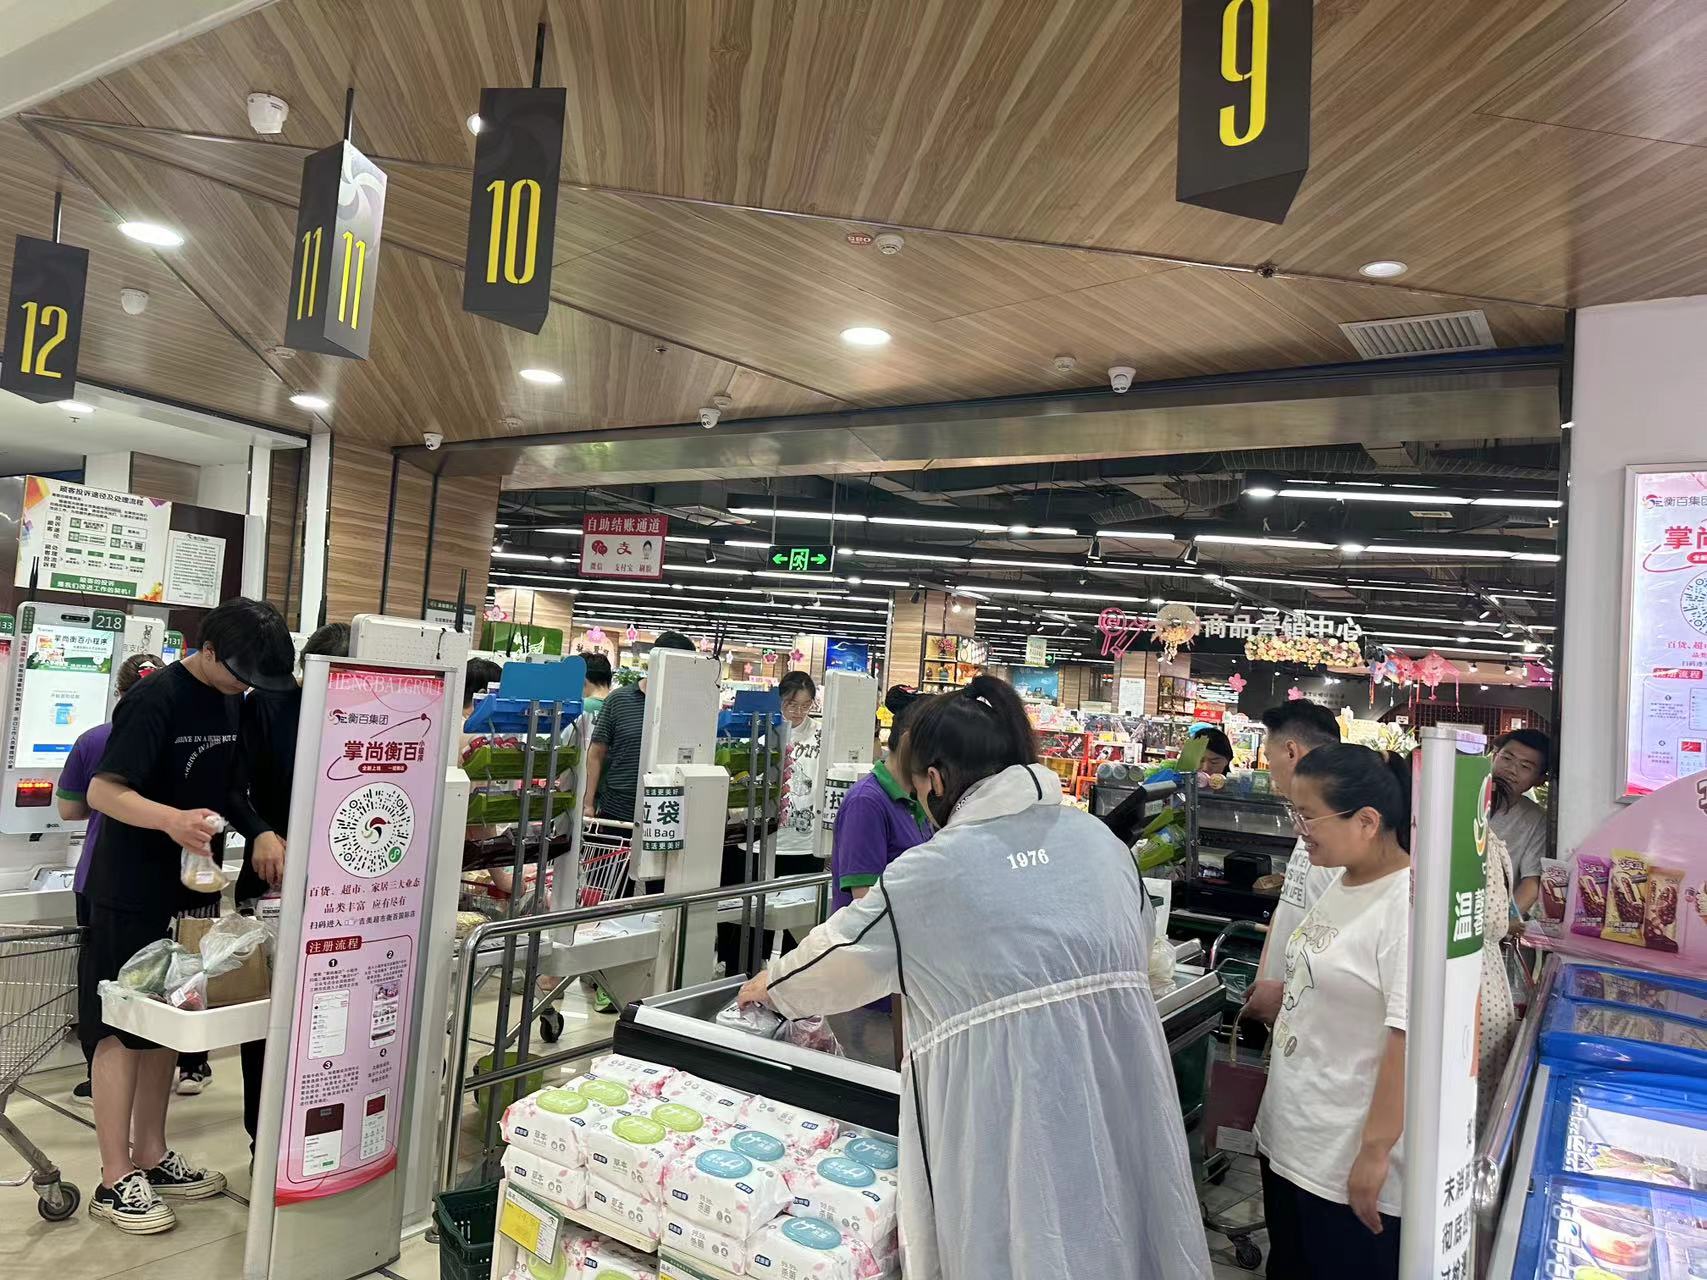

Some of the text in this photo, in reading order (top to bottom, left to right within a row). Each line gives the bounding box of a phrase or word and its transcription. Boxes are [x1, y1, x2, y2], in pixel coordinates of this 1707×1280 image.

[1219, 0, 1269, 147] 9
[486, 179, 541, 285] 10
[296, 226, 322, 321] 11
[337, 231, 365, 330] 11
[21, 301, 68, 379] 12
[587, 517, 661, 533] 自助结账通道
[96, 615, 122, 630] 218
[169, 637, 180, 646] 131
[348, 713, 389, 725] 衡百集团
[343, 740, 418, 761] 掌尚衡百
[655, 829, 675, 839] Bag
[1007, 848, 1050, 869] 1976
[324, 896, 407, 914] 品类丰富 应有尽有
[310, 919, 343, 930] 扫码进入
[309, 938, 359, 954] 注册流程
